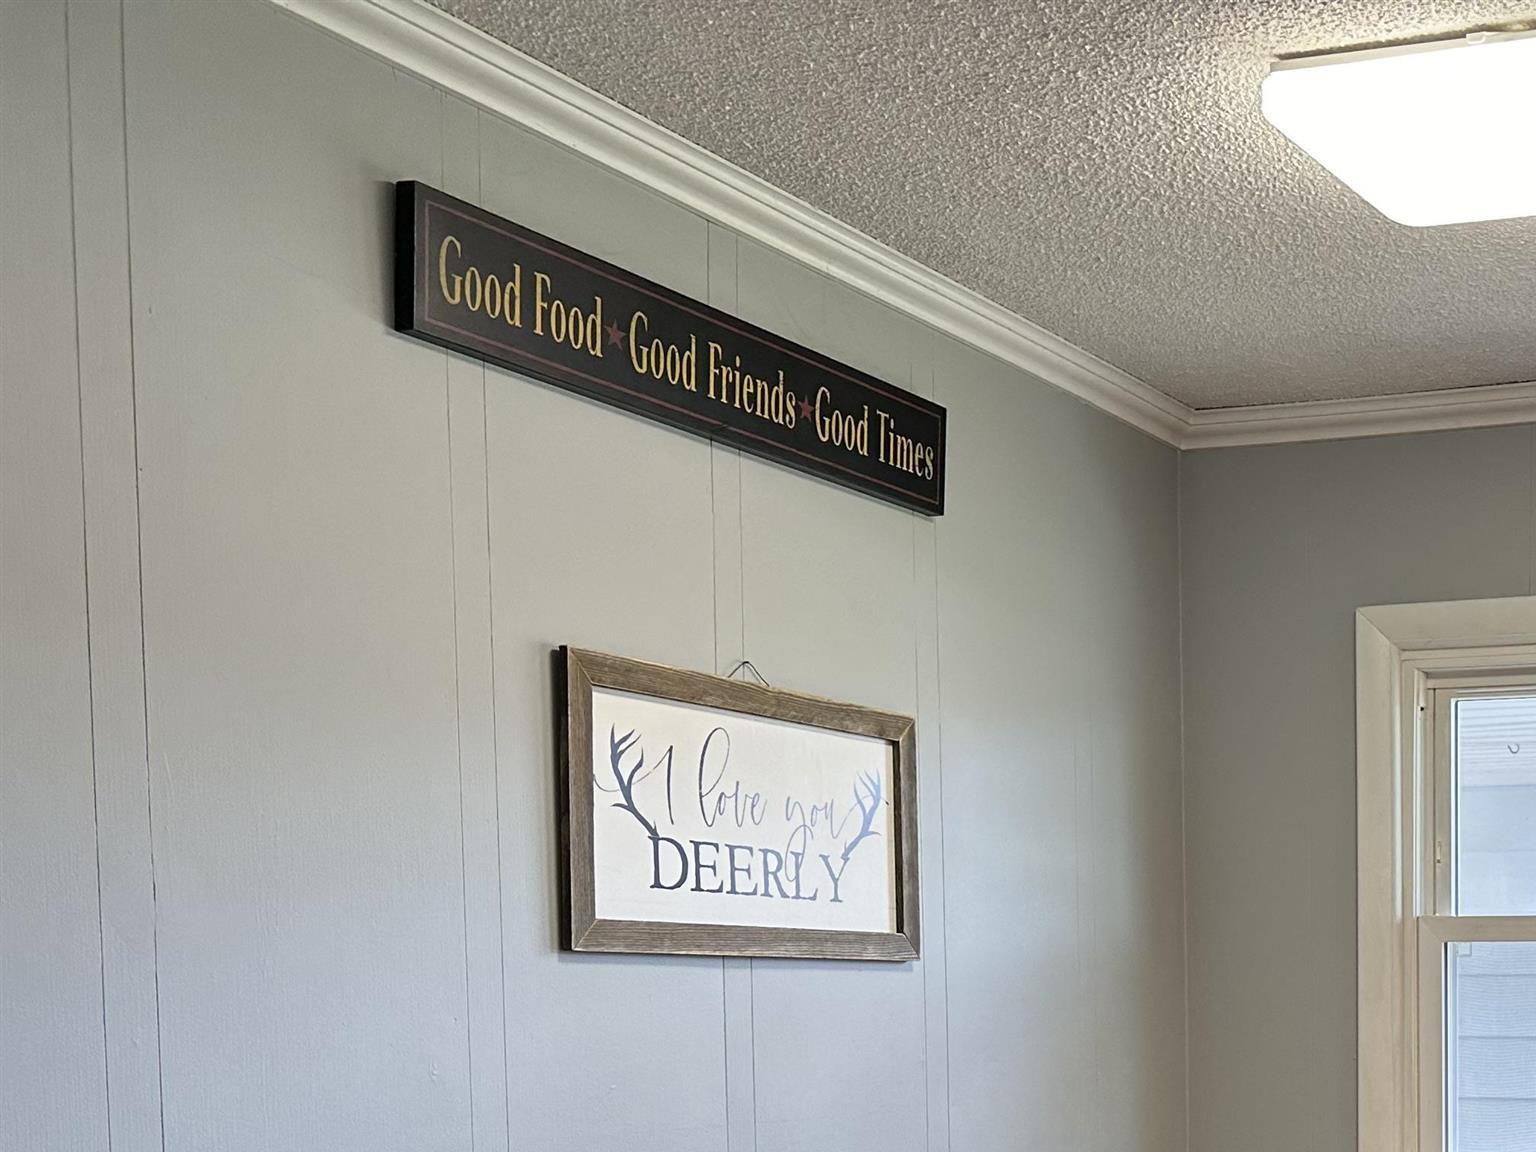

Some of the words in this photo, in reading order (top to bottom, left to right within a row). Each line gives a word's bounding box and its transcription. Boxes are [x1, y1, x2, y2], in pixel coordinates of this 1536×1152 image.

[438, 235, 522, 328] Good
[533, 271, 604, 358] Food
[628, 311, 698, 393] Good
[707, 342, 797, 429] Friends
[814, 386, 870, 458] Good
[876, 409, 935, 481] Times
[648, 834, 850, 903] DEERLY
[698, 726, 768, 828] love
[784, 795, 849, 884] you
